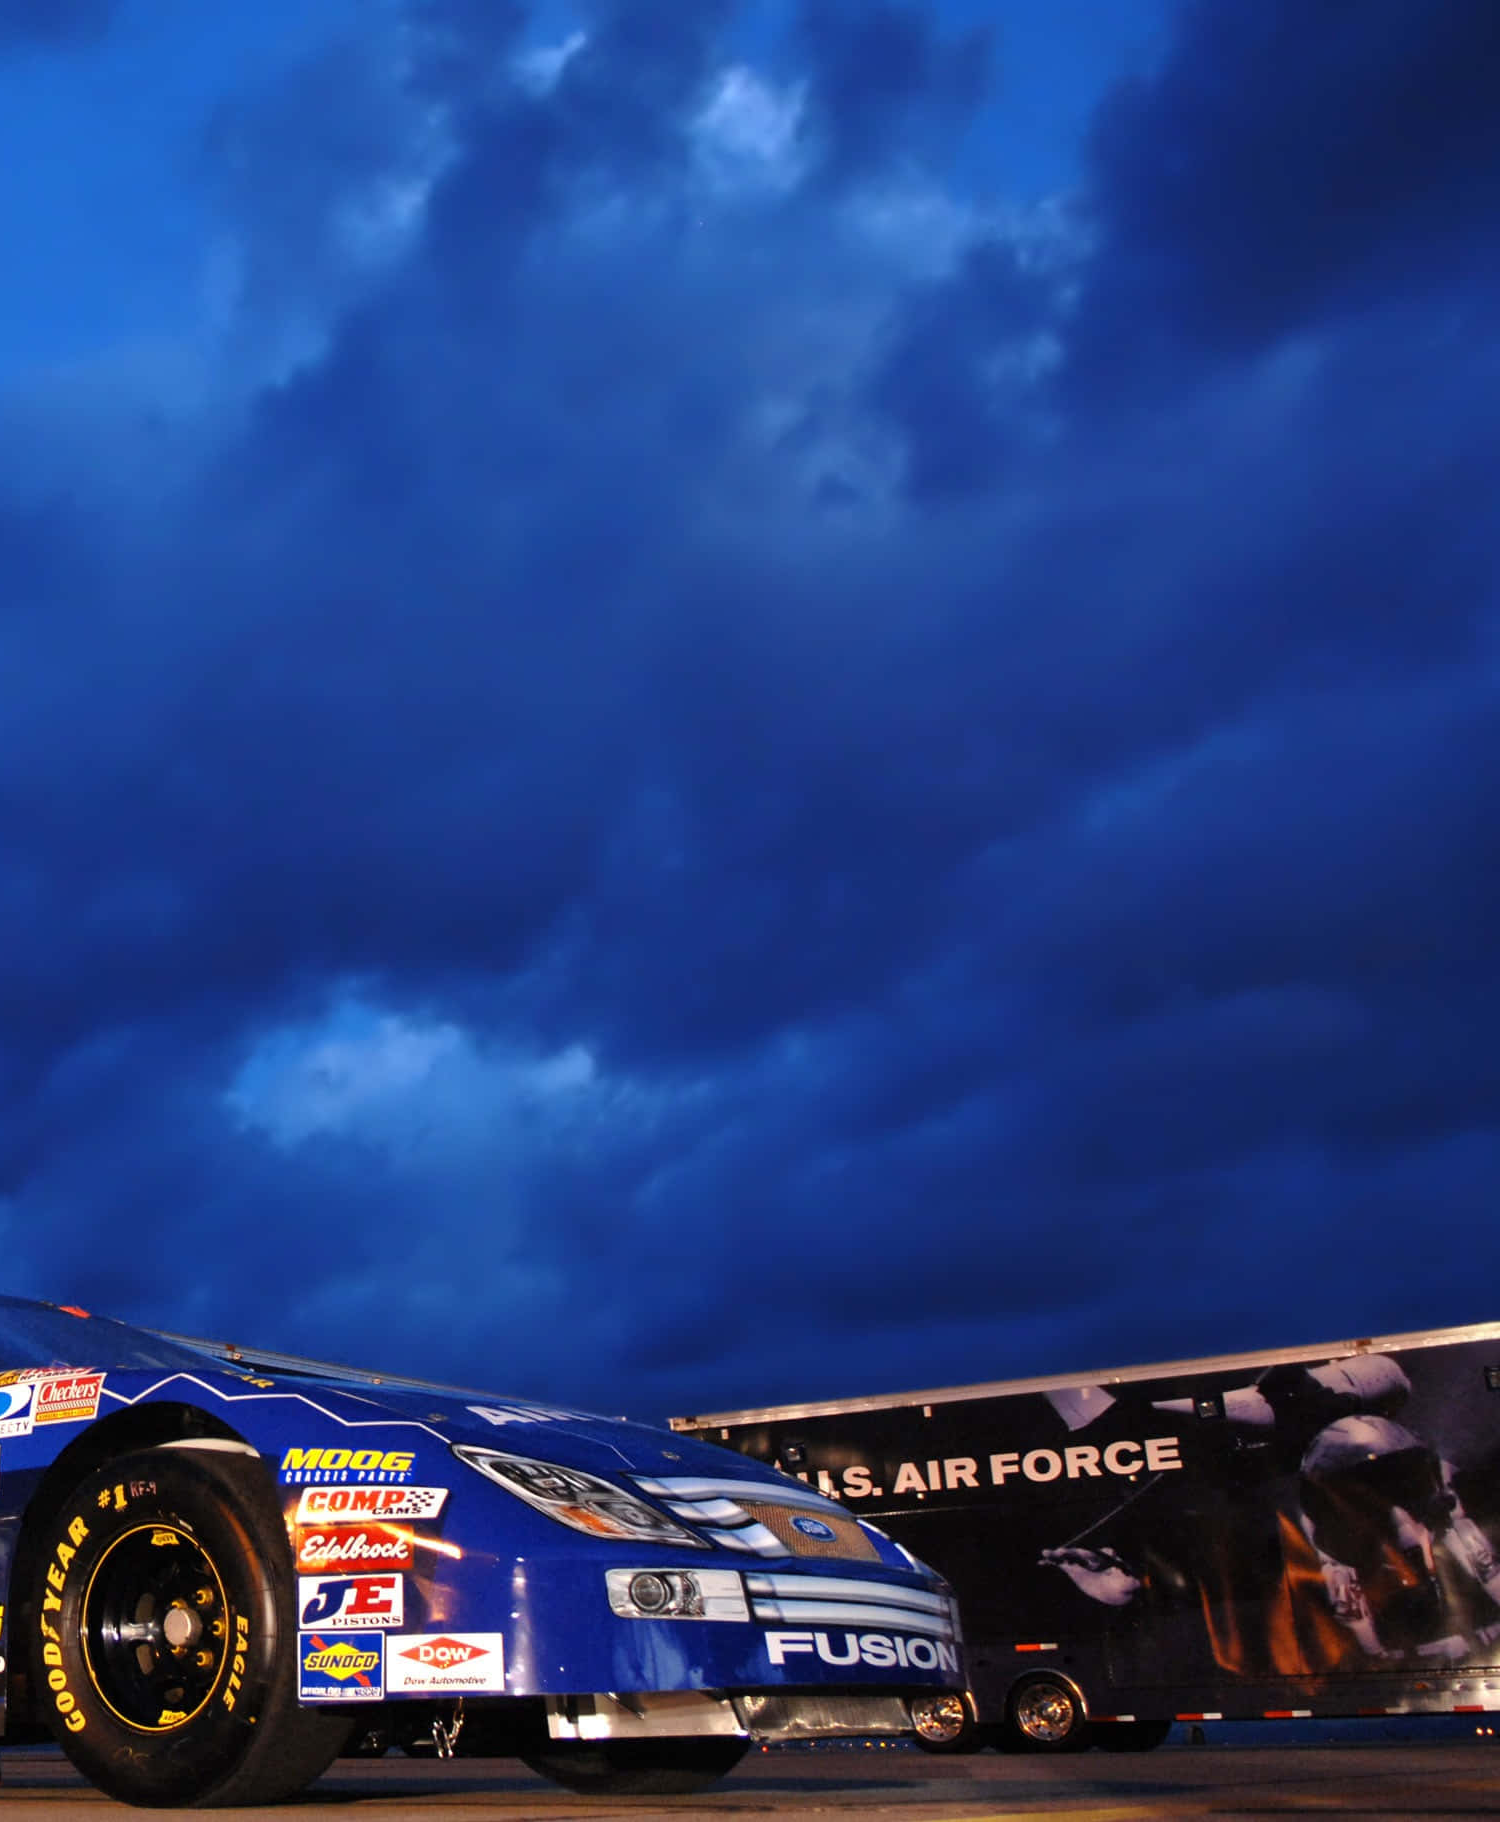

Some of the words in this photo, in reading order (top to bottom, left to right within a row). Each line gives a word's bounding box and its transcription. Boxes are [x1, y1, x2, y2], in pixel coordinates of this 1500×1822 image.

[40, 1379, 98, 1403] Checkers
[281, 1448, 416, 1471] MOOG
[893, 1457, 980, 1494] AIR
[989, 1436, 1183, 1486] FORCE
[285, 1470, 348, 1483] CHASSIS
[307, 1489, 406, 1512] COMP
[372, 1506, 422, 1515] CAMS
[300, 1533, 409, 1562] Edelbrock
[41, 1515, 91, 1733] GOODYEAR
[97, 1484, 129, 1511] #1
[302, 1577, 396, 1625] JE
[331, 1616, 401, 1626] PISTONS
[223, 1615, 249, 1712] EAGLE
[307, 1654, 376, 1669] SUNOCO
[419, 1646, 472, 1661] DOW
[764, 1631, 959, 1673] FUSION
[404, 1676, 427, 1686] Dow
[430, 1675, 487, 1686] Automotive
